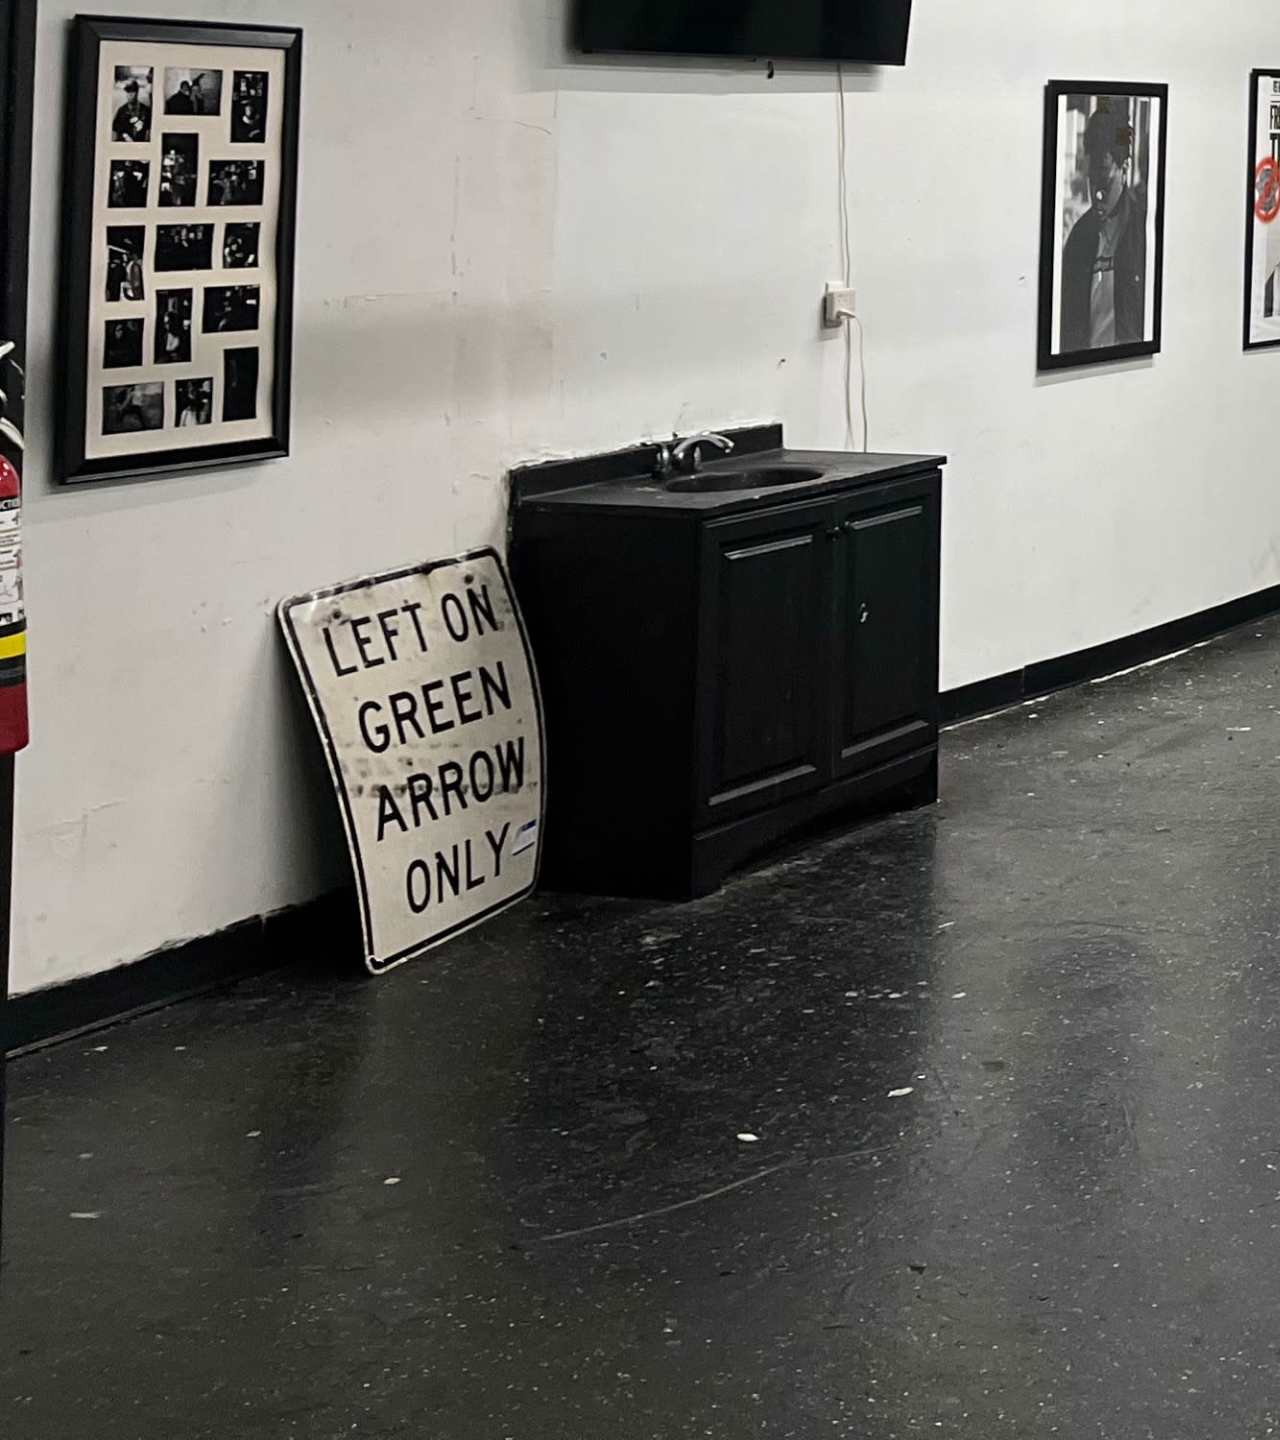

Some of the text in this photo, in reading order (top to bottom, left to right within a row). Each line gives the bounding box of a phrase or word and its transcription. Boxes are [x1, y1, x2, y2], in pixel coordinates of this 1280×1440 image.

[322, 584, 500, 678] LEFT ON
[357, 661, 512, 755] GREEN
[376, 736, 527, 843] ARROW
[406, 821, 512, 915] ONLY
